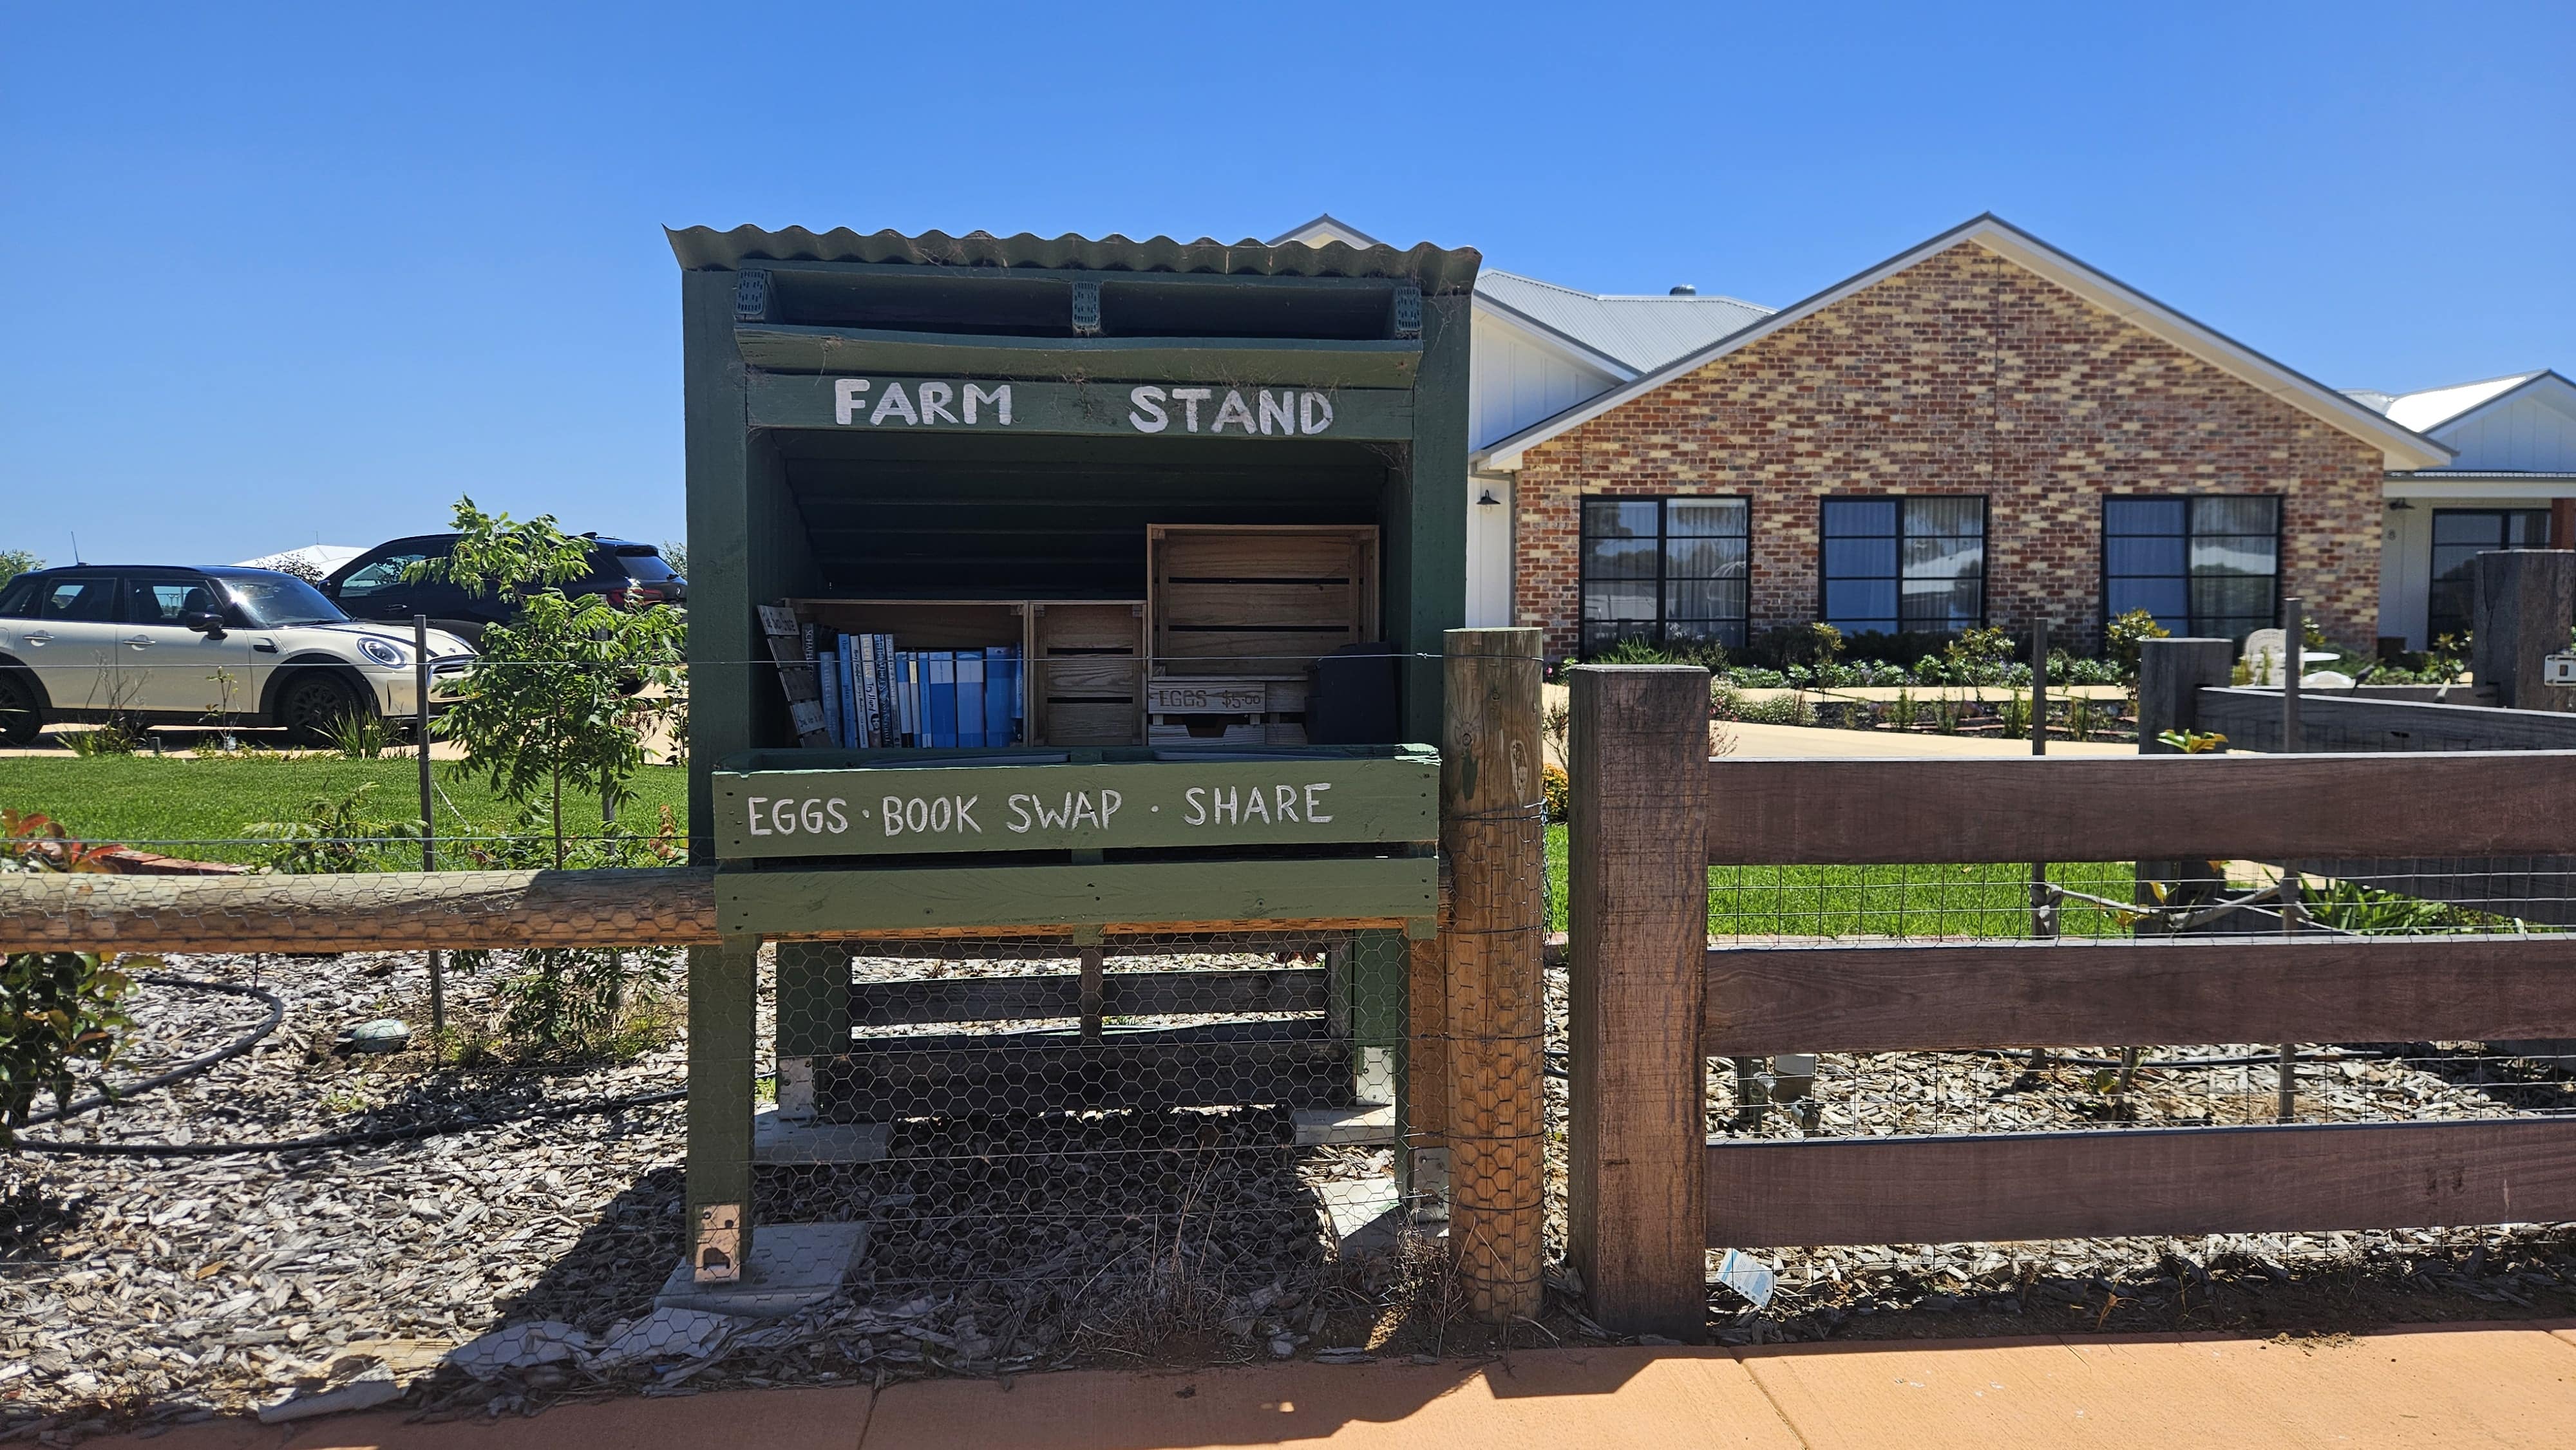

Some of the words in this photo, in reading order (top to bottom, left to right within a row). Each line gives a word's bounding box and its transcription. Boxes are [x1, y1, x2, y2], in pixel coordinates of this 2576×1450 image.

[835, 379, 1012, 426] FARM
[1129, 386, 1333, 435] STAND
[866, 683, 874, 693] Try
[1159, 690, 1208, 708] EGGS
[748, 796, 848, 836] EGGS
[883, 795, 981, 836] BOOK
[1006, 790, 1122, 833] SWAP
[1184, 783, 1333, 826] SHARE
